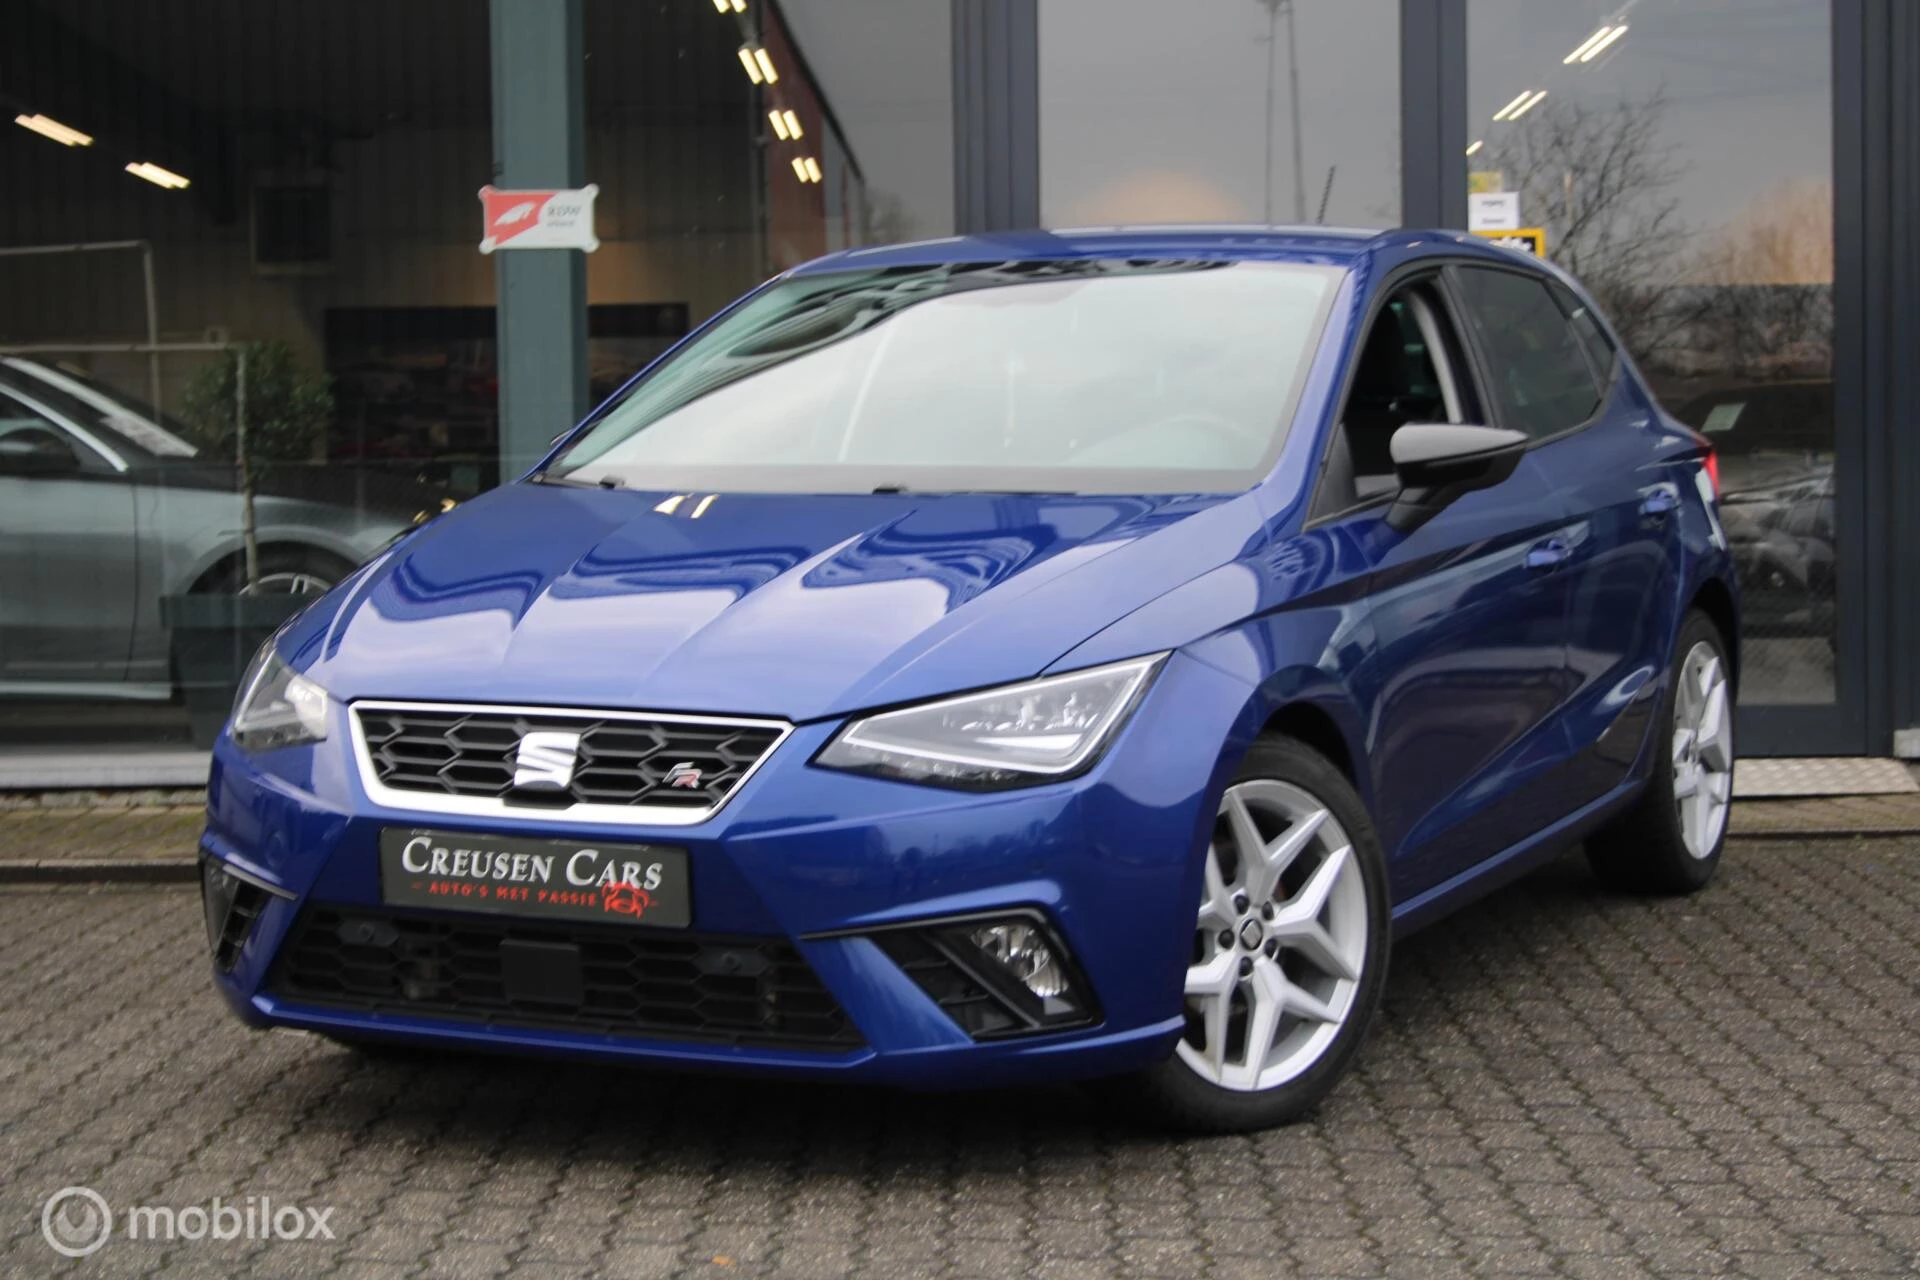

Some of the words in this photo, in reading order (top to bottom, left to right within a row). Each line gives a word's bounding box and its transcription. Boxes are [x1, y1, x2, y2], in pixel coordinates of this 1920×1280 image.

[401, 836, 555, 883] CREUSEN
[565, 849, 663, 890] CARS
[428, 881, 489, 898] AUTO'S
